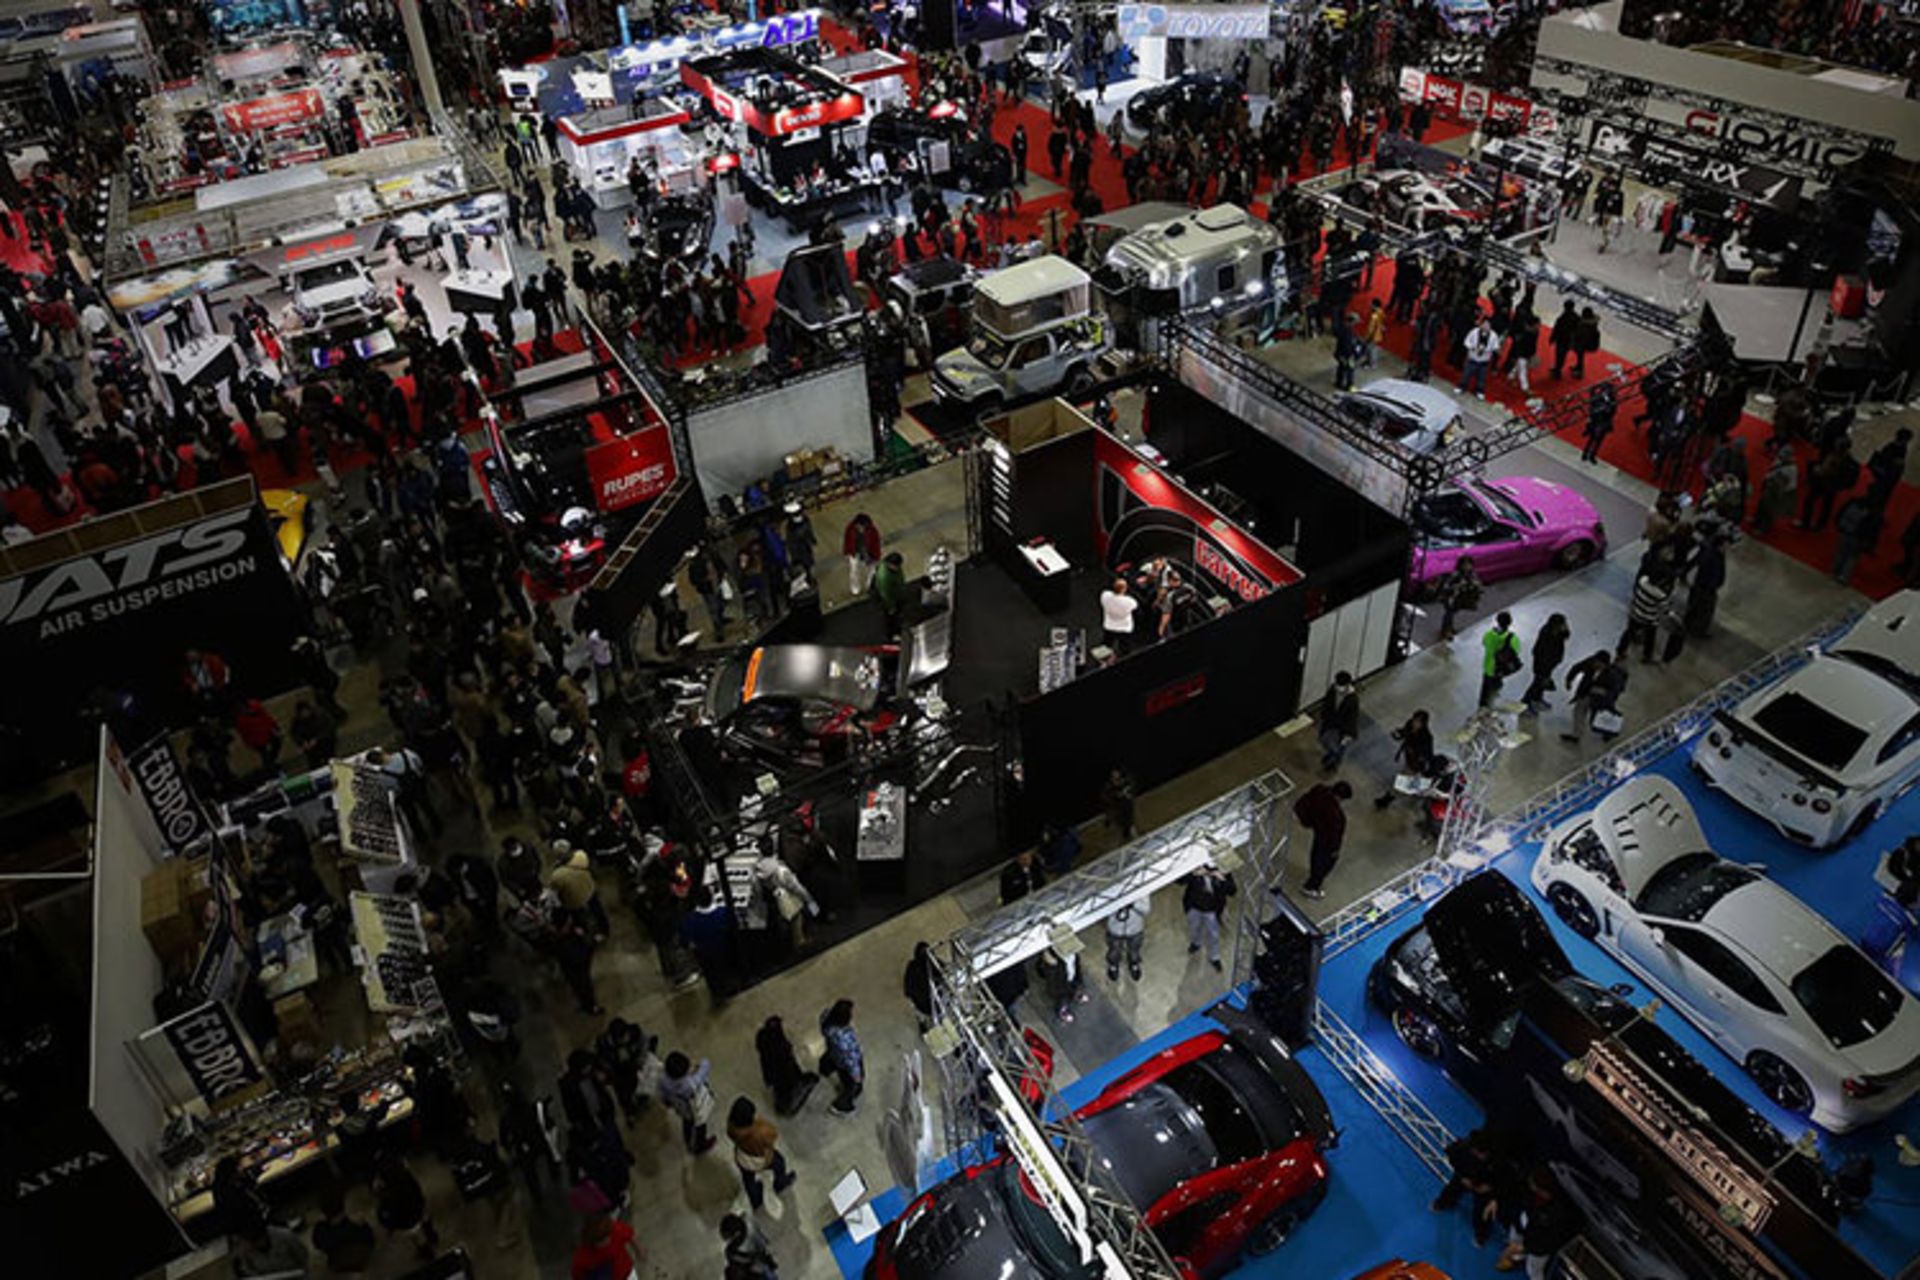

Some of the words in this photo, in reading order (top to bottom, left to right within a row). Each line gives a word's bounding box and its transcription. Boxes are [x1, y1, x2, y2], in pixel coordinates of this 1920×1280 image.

[1166, 11, 1268, 37] TOYOTA
[603, 462, 666, 497] RUPES
[40, 610, 85, 640] AIR
[90, 556, 256, 623] SUSPENSION
[138, 744, 198, 843] EBBRO
[17, 1151, 108, 1199] AIWA
